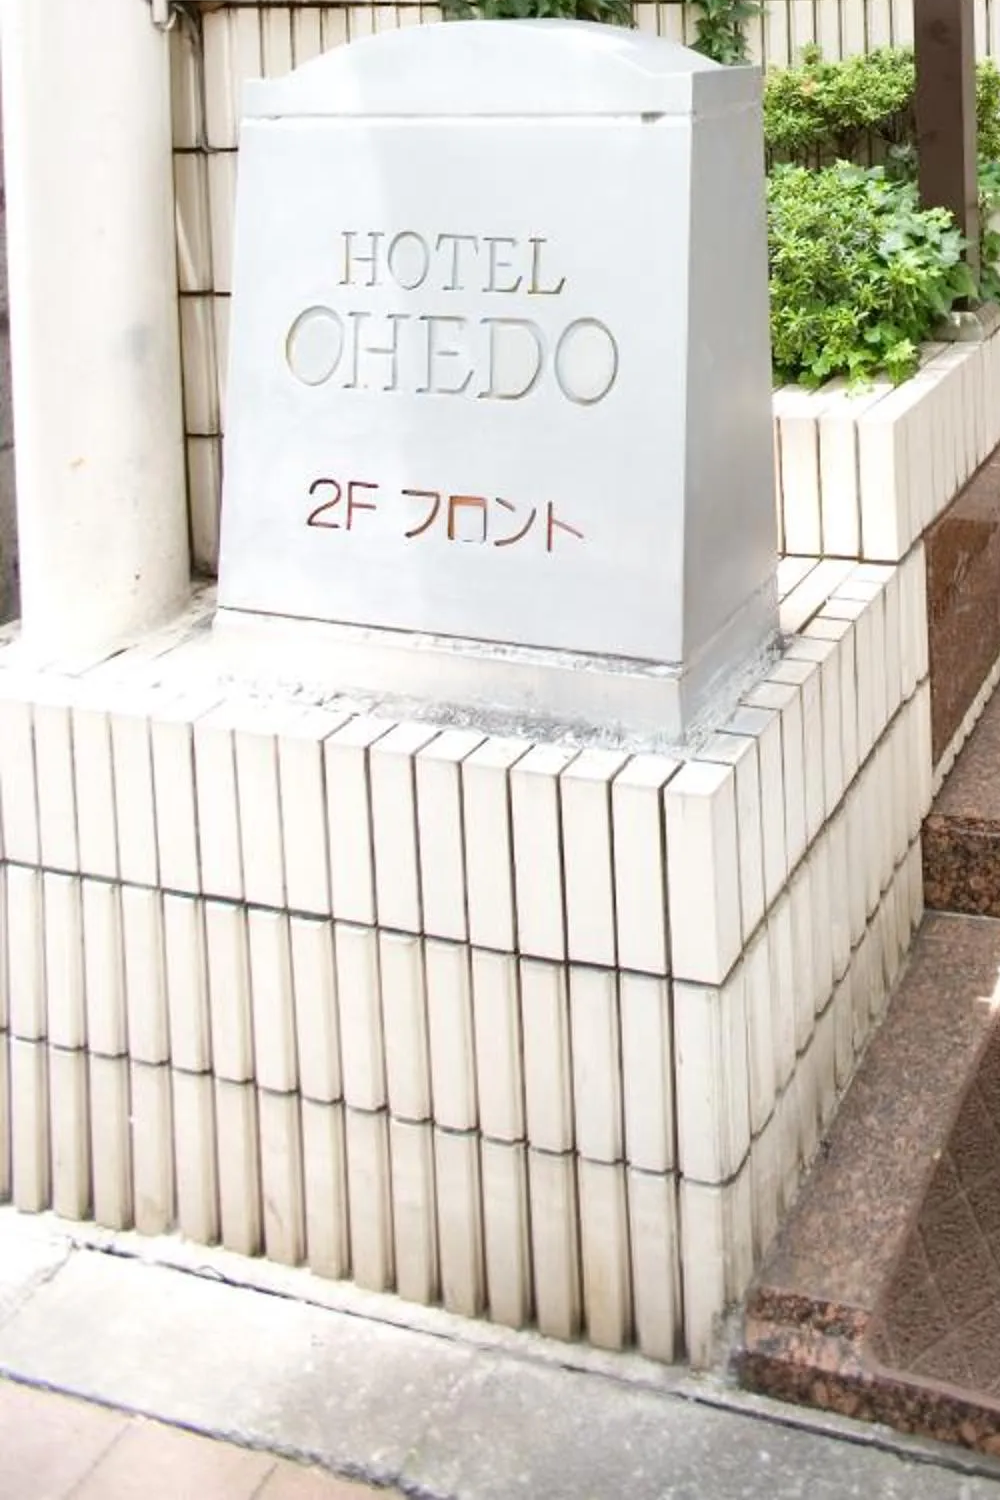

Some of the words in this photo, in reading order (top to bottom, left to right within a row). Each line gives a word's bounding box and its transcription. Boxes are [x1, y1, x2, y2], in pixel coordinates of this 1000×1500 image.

[337, 230, 566, 295] HOTEL
[285, 305, 619, 408] OHEDO
[306, 478, 379, 531] 2F
[401, 488, 584, 553] フロント
